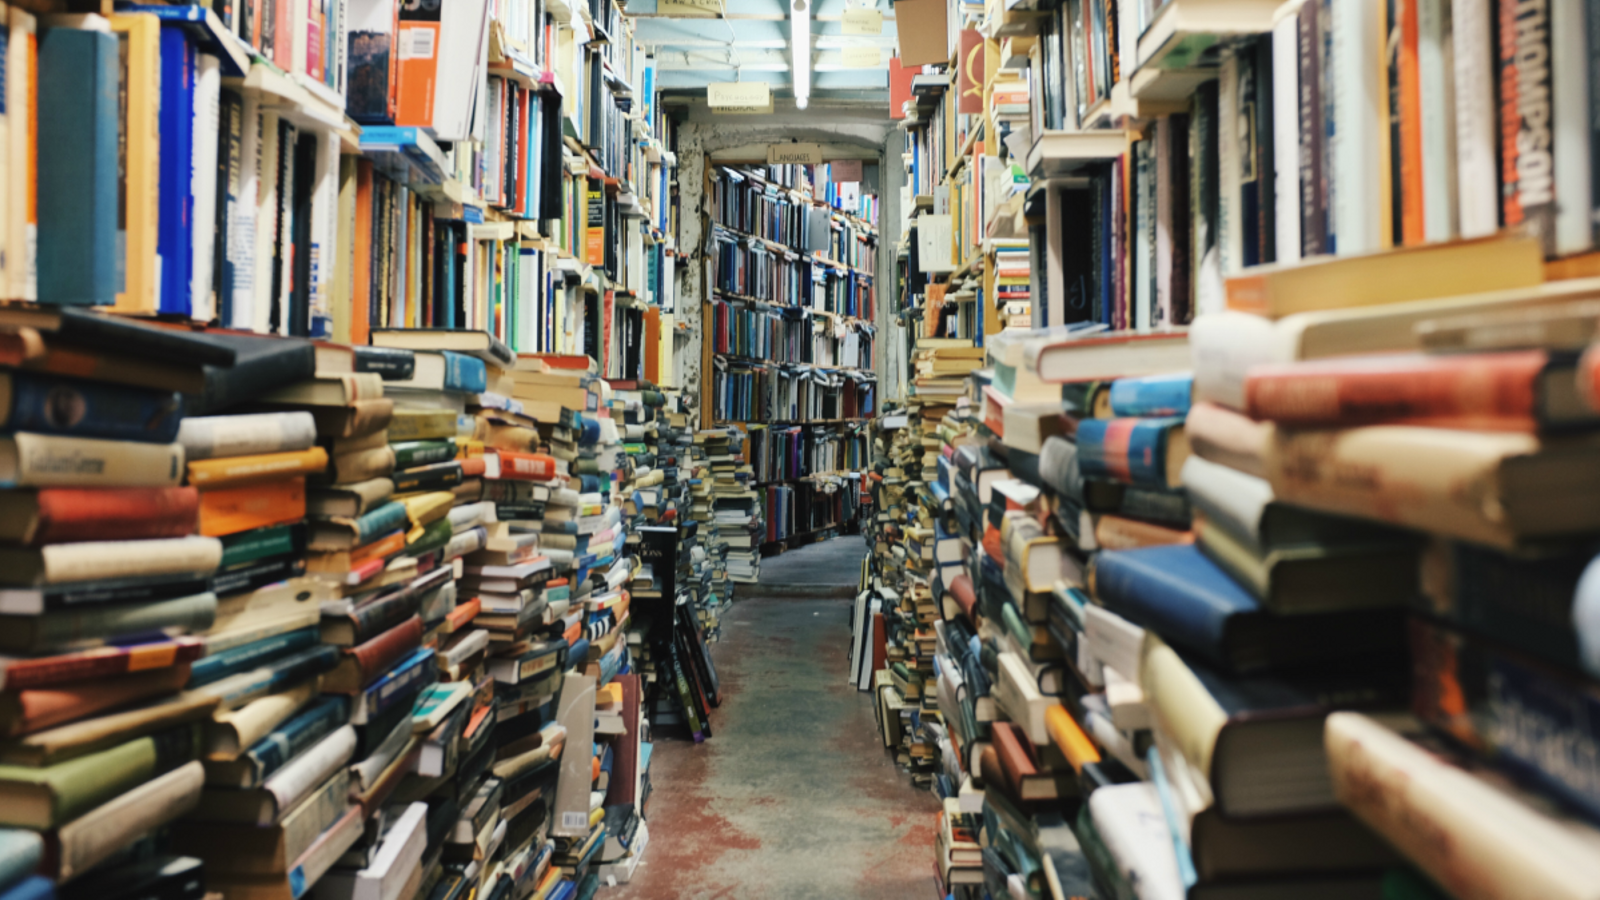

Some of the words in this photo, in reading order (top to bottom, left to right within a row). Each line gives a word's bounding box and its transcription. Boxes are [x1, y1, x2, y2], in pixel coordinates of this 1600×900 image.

[713, 90, 764, 102] PSYCHOLOGY
[1517, 0, 1554, 207] THOMPSON
[772, 147, 810, 162] LANGUAGES
